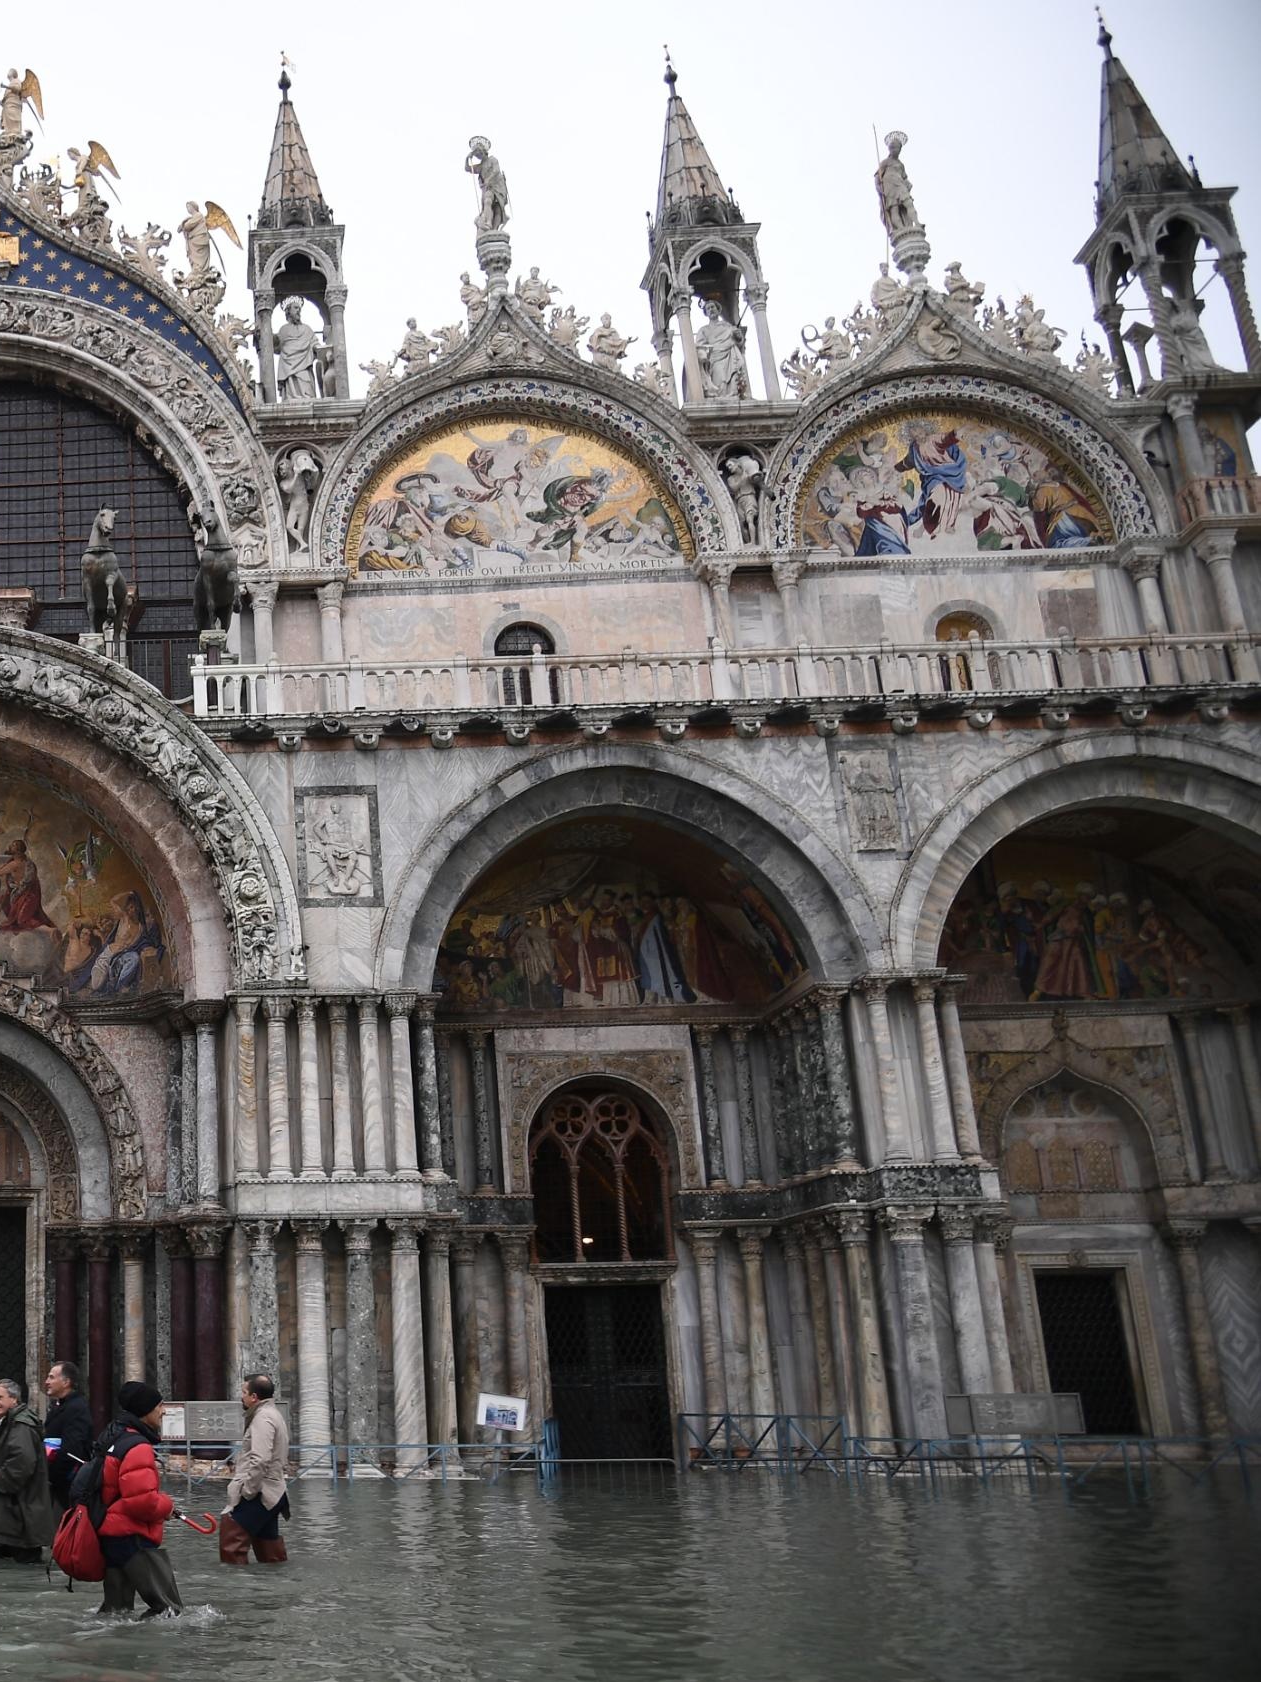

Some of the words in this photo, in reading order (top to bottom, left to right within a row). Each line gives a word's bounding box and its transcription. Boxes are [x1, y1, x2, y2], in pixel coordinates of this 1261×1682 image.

[367, 571, 383, 580] EN
[392, 568, 430, 579] VERVS
[438, 568, 474, 578] FORTIS
[512, 563, 552, 574] FREGIT
[559, 561, 615, 572] VINCVLA
[620, 559, 668, 570] MORTIS
